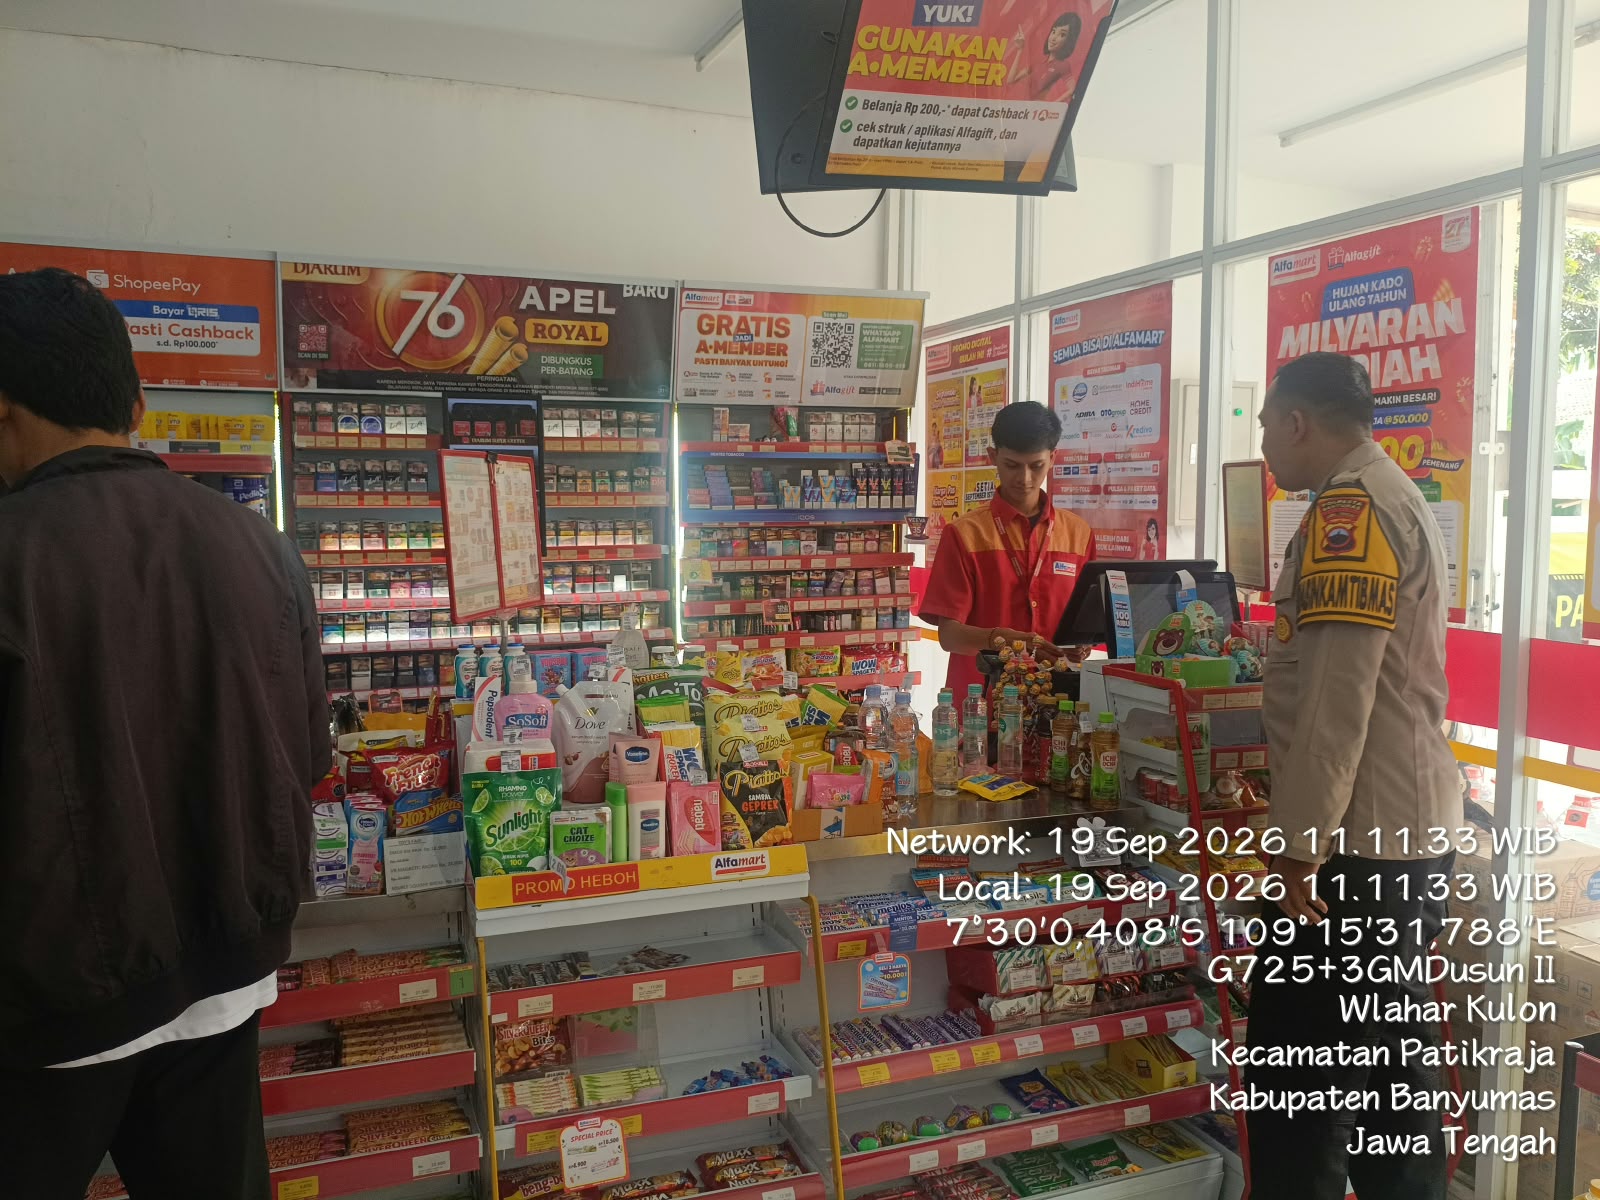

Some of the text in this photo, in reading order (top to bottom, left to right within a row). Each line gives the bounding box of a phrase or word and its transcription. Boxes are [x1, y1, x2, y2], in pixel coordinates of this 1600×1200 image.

[922, 4, 973, 25] YUK!
[857, 25, 1008, 61] GUNAKAN
[862, 99, 903, 114] Belanja
[904, 102, 919, 117] Rp
[951, 105, 981, 120] dapat
[982, 107, 1029, 122] Cashback
[857, 122, 876, 133] cek
[878, 123, 906, 135] struk
[907, 124, 913, 135] /
[914, 125, 956, 139] aplikasi
[999, 129, 1018, 141] dan
[853, 136, 962, 154] dapatkan kejutannya
[1343, 244, 1381, 265] Alfagift
[293, 262, 362, 277] DJARUM
[1273, 254, 1316, 274] Alfamart
[113, 274, 201, 301] ShopeePay
[622, 283, 669, 300] BARU
[1332, 275, 1403, 300] HUJAN KADO
[519, 285, 617, 316] APEL
[685, 292, 720, 302] Alfamart
[1328, 288, 1407, 313] ULANG TAHUN
[153, 305, 185, 321] Bayar
[391, 273, 466, 357] 76
[1054, 312, 1079, 326] Alfamart
[168, 323, 254, 341] Cashback
[532, 323, 604, 343] ROYAL
[696, 313, 791, 339] GRATIS
[1277, 297, 1467, 360] MILYARAN
[156, 340, 171, 348] s.d.
[1053, 349, 1081, 364] SEMUA
[1082, 341, 1101, 354] BISA
[1112, 330, 1165, 348] ALFAMART
[541, 355, 593, 368] DIBUNGKUS
[694, 357, 788, 368] PASTI BANYAK UNTUNG!
[540, 366, 594, 378] PER-BATANG
[825, 386, 856, 396] Alfagift
[1130, 400, 1150, 408] HOME
[1374, 391, 1437, 409] MAKIN BESAR!
[1130, 407, 1152, 416] CREDIT
[1383, 413, 1429, 426] @50.000
[1422, 458, 1460, 474] PEMENANG
[1115, 611, 1130, 620] 100
[851, 658, 877, 671] WOW
[633, 671, 670, 684] hottest
[485, 689, 498, 739] Pepsodent
[507, 714, 548, 727] SoSoft
[574, 716, 606, 730] Dove
[383, 754, 441, 787] French
[498, 785, 528, 793] RHAMNO
[725, 767, 790, 797] Piattos
[501, 790, 525, 799] power
[748, 793, 772, 801] SAMBAL
[742, 799, 779, 813] GEPREK
[694, 799, 705, 831] nabati
[485, 808, 543, 848] Sunlight
[570, 827, 588, 835] CAT
[563, 834, 595, 843] CHOIZE
[714, 853, 766, 869] Alfamart
[515, 871, 636, 898] PROMO HEBOH
[876, 902, 912, 915] mentos
[498, 1022, 551, 1041] SILVERQUEEN
[532, 1035, 556, 1047] Bites
[359, 1124, 430, 1143] SILVERQUEEN
[570, 1128, 613, 1143] SPECIAL PRICE
